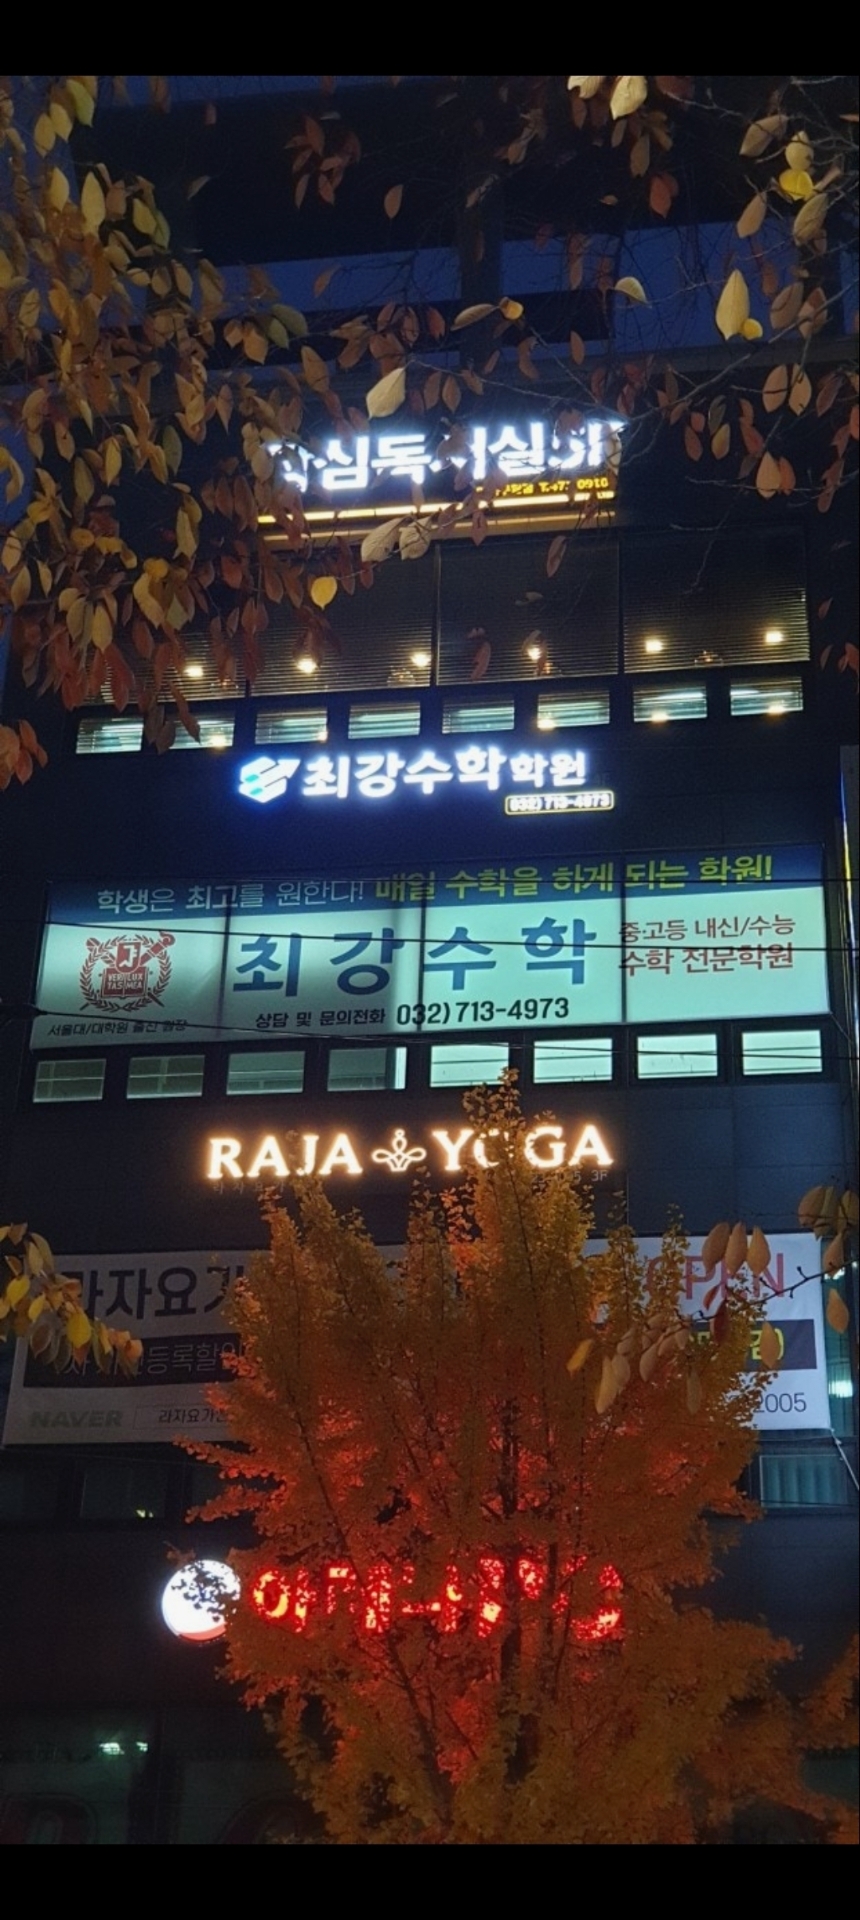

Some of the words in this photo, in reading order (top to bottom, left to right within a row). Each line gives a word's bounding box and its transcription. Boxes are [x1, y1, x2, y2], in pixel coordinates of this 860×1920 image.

[98, 887, 173, 914] 학생은
[186, 883, 264, 910] 최고를
[277, 881, 364, 907] 원한다!
[376, 871, 435, 902] 매일
[446, 866, 542, 899] 수학을
[552, 862, 614, 893] 하게
[625, 861, 689, 890] 되는
[699, 855, 773, 883] 학원!
[695, 914, 796, 939] 내신/수능
[619, 948, 675, 976] 수학
[681, 942, 793, 974] 전문학원
[47, 1020, 129, 1037] 서울대/대학원
[256, 1012, 289, 1029] 상담
[296, 1011, 312, 1027] 및
[320, 1008, 386, 1026] 문의전화
[207, 1132, 364, 1179] RAJA
[29, 1409, 123, 1428] NAVER
